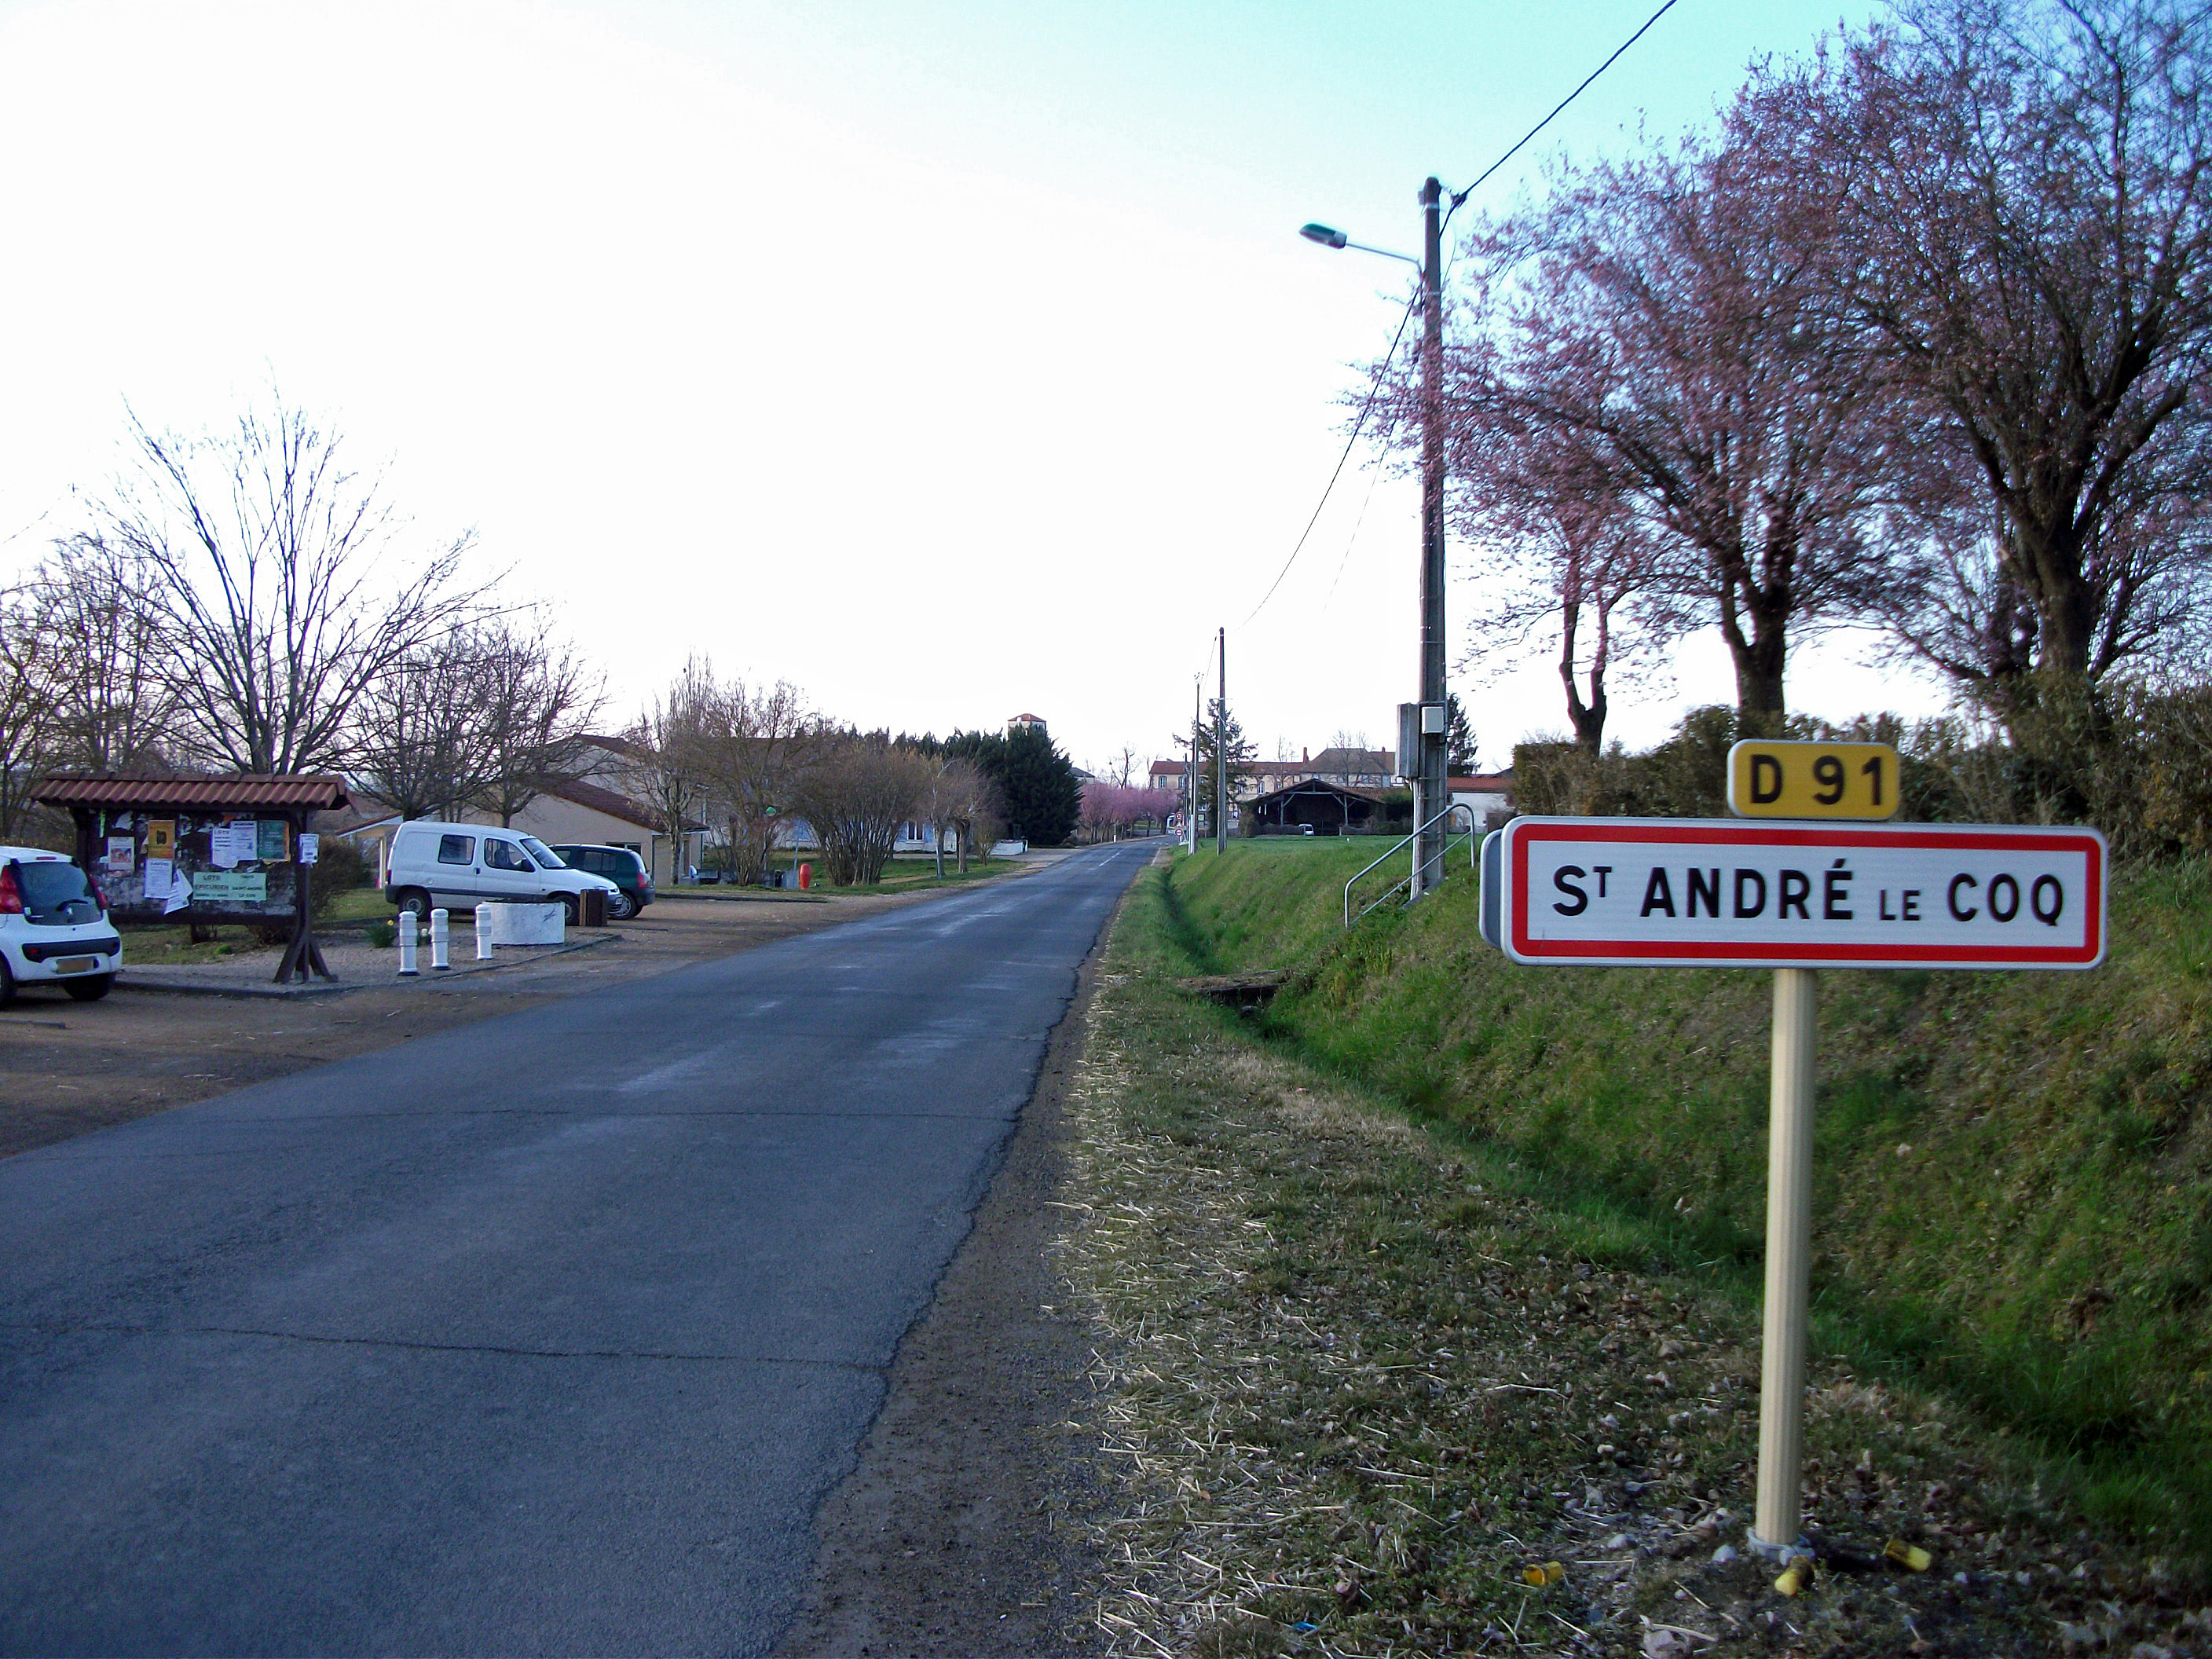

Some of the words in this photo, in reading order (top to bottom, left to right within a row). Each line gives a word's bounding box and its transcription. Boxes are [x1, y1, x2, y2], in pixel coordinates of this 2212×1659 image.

[1750, 754, 1785, 804] D
[1811, 754, 1883, 806] 91
[1640, 858, 1854, 921] ANDRÉ
[1879, 889, 1921, 921] LE
[1946, 872, 2064, 927] COQ
